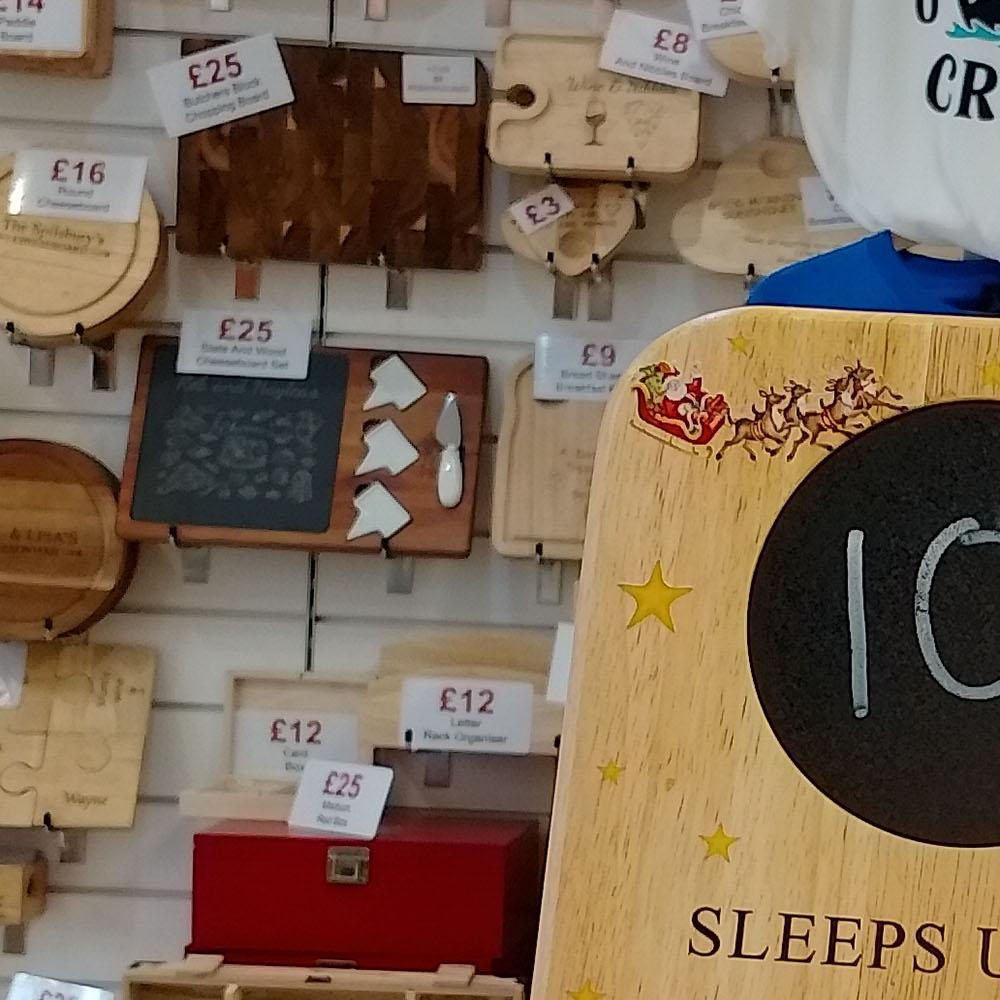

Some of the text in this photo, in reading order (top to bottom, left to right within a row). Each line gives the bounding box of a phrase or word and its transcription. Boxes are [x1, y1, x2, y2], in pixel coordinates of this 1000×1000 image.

[653, 28, 689, 54] £8
[188, 52, 242, 89] £25
[52, 158, 106, 185] £16
[525, 196, 560, 225] £3
[219, 317, 273, 342] £25
[582, 344, 616, 367] £9
[440, 687, 495, 714] £12
[270, 718, 322, 744] £12
[322, 770, 363, 799] £25
[687, 906, 946, 974] SLEEPS
